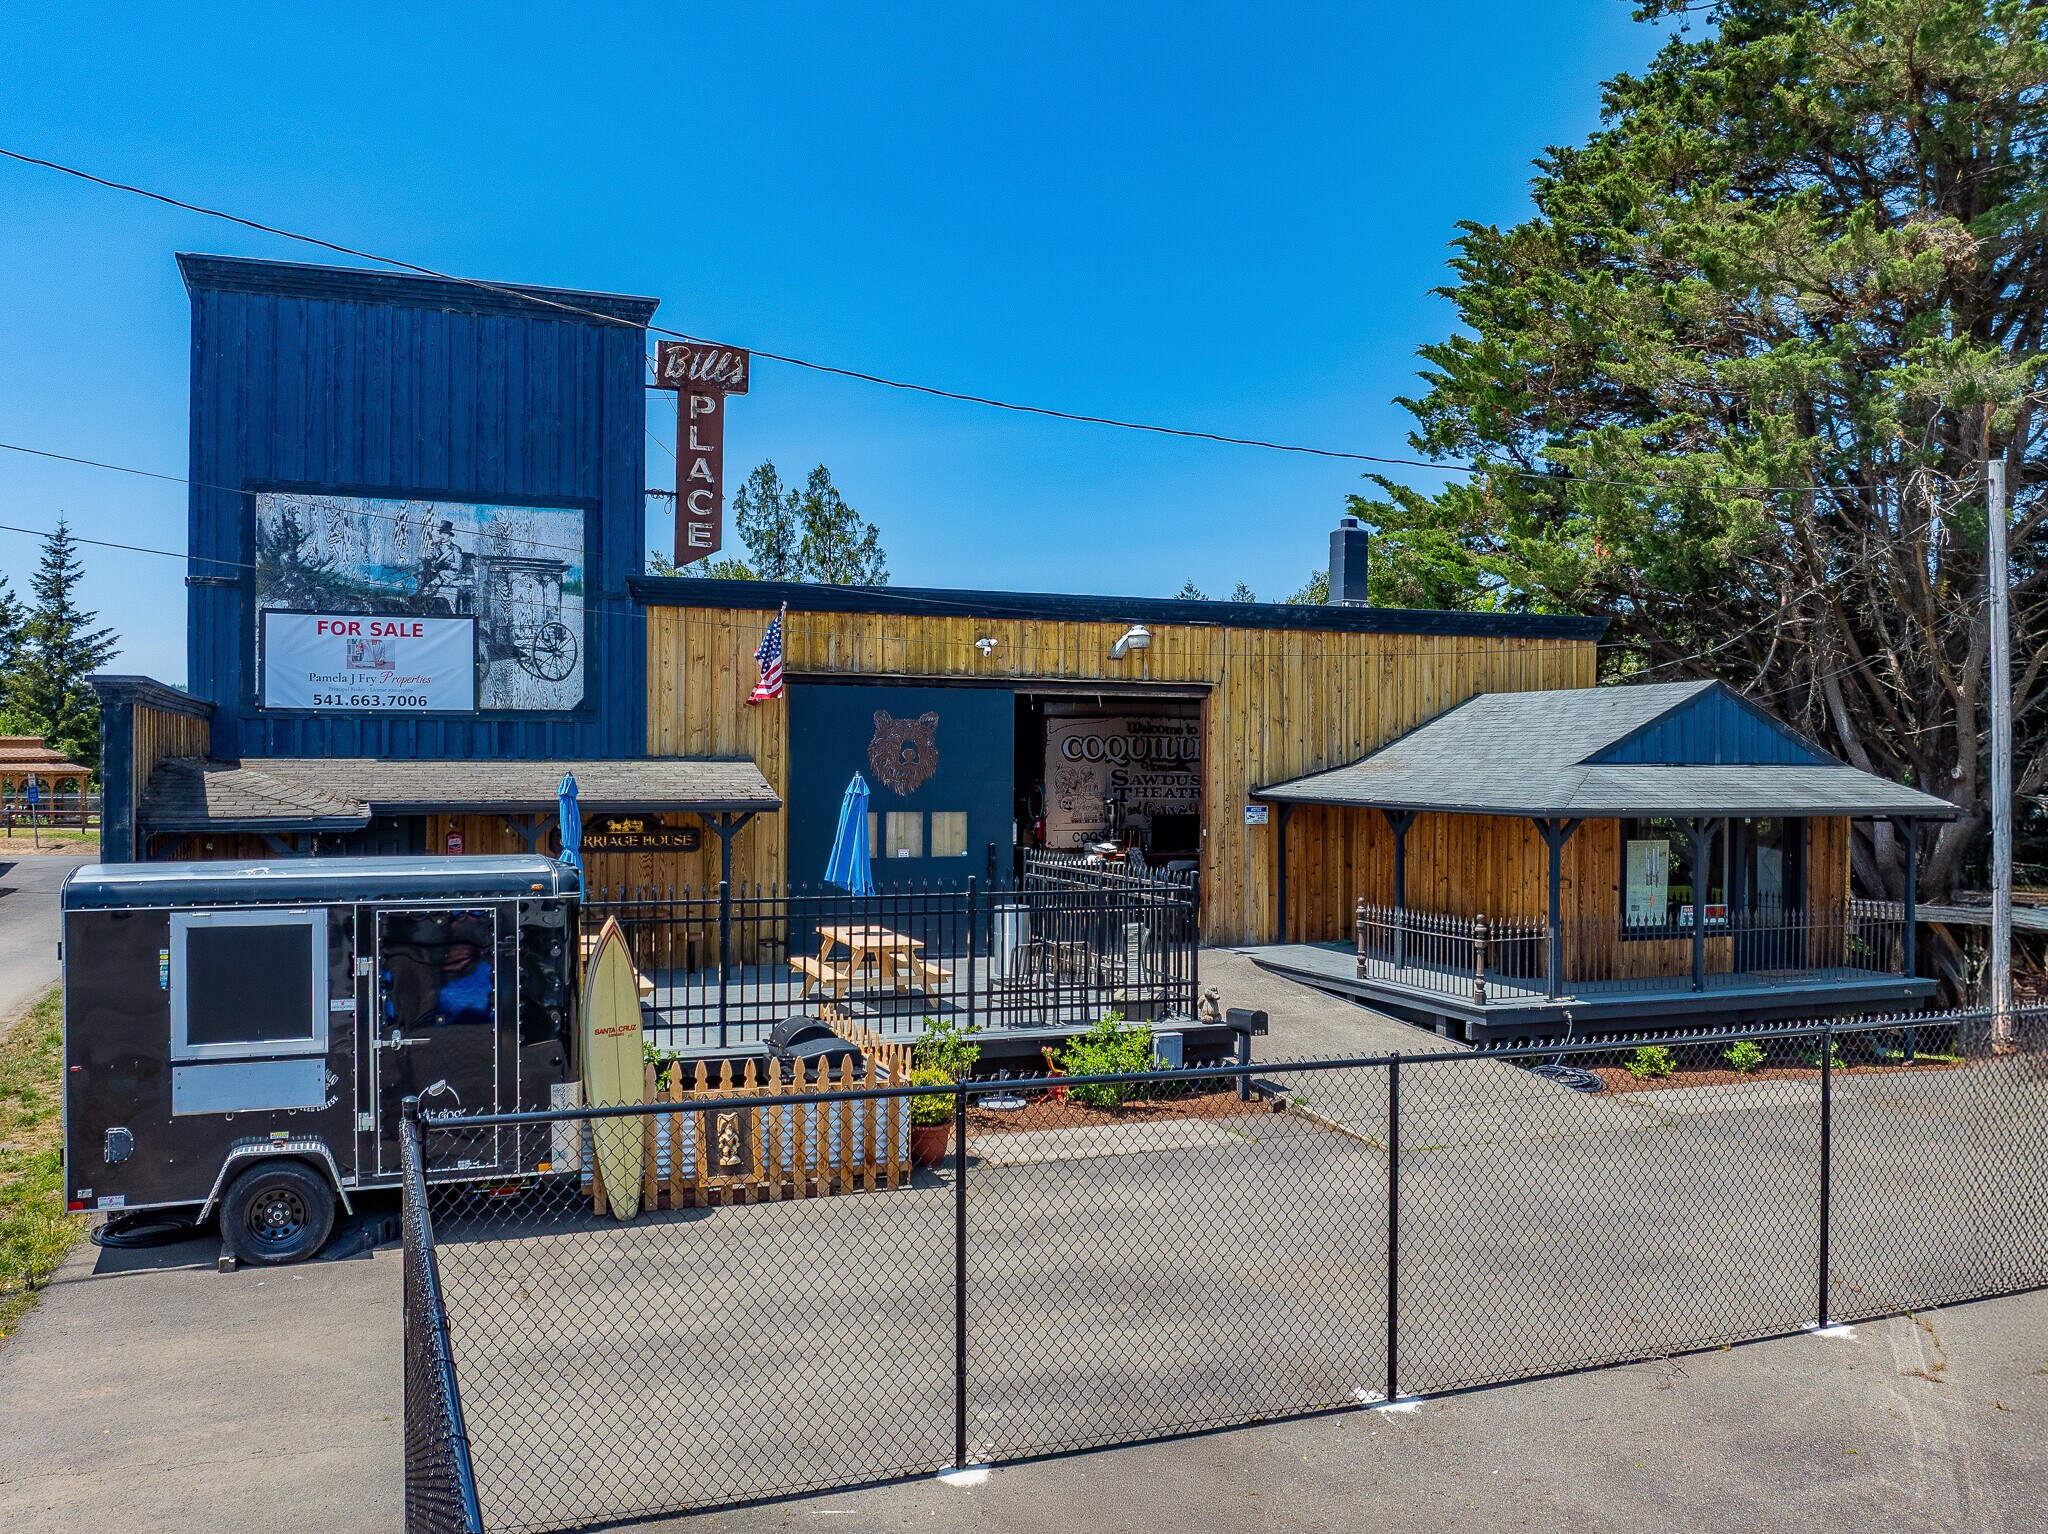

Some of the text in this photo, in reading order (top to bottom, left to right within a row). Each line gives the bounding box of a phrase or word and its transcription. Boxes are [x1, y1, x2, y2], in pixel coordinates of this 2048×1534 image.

[686, 394, 716, 548] PLACE
[317, 621, 423, 637] FOR SALE
[308, 671, 432, 687] Pamela J Fry Properties
[313, 694, 428, 707] 541.663.7006
[1127, 721, 1198, 736] Welcome to
[1111, 768, 1200, 786] SAWDUS
[1114, 787, 1200, 802] THEATR
[560, 835, 692, 848] RRIAGE HOUSE
[594, 1027, 615, 1035] SANTA
[618, 1024, 637, 1032] CRUZ
